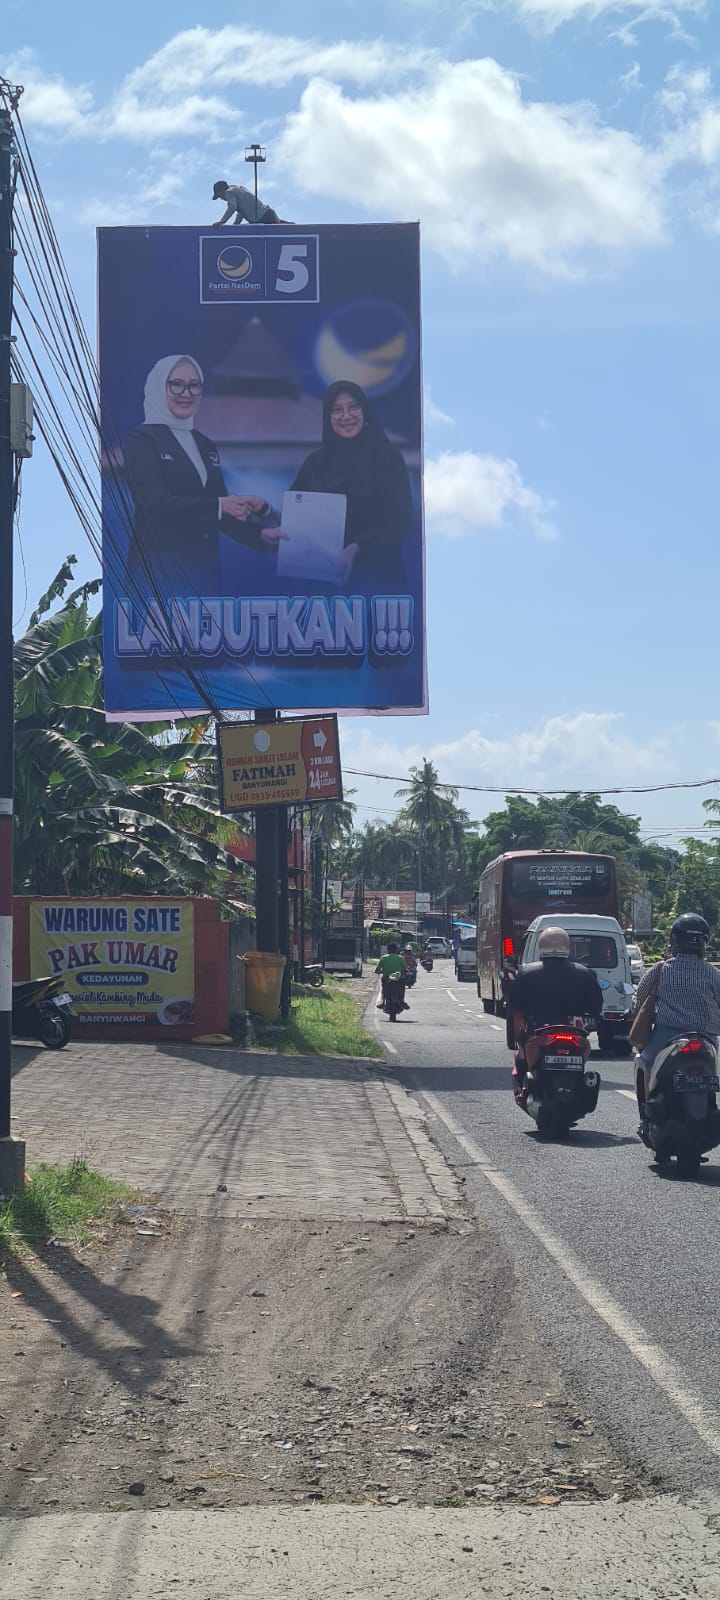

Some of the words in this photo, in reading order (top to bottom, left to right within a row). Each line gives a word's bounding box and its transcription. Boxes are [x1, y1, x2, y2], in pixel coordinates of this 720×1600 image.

[275, 244, 309, 294] 5
[209, 281, 231, 289] Partai
[231, 281, 261, 289] NasDem
[113, 596, 367, 657] LANJUTKAN
[371, 595, 415, 656] !!!
[277, 752, 299, 763] ISLAM
[232, 764, 296, 782] FATIMAH
[242, 779, 288, 790] BANYUWANGI
[230, 791, 249, 802] UGD
[44, 907, 128, 933] WARUNG
[133, 907, 182, 933] SATE
[48, 942, 101, 973] PAK
[106, 941, 179, 973] UMAR
[82, 974, 143, 983] KEDAYUNAN
[96, 991, 137, 1008] Kambing
[136, 991, 163, 1004] Muda
[79, 1015, 146, 1023] BANYUWANGI
